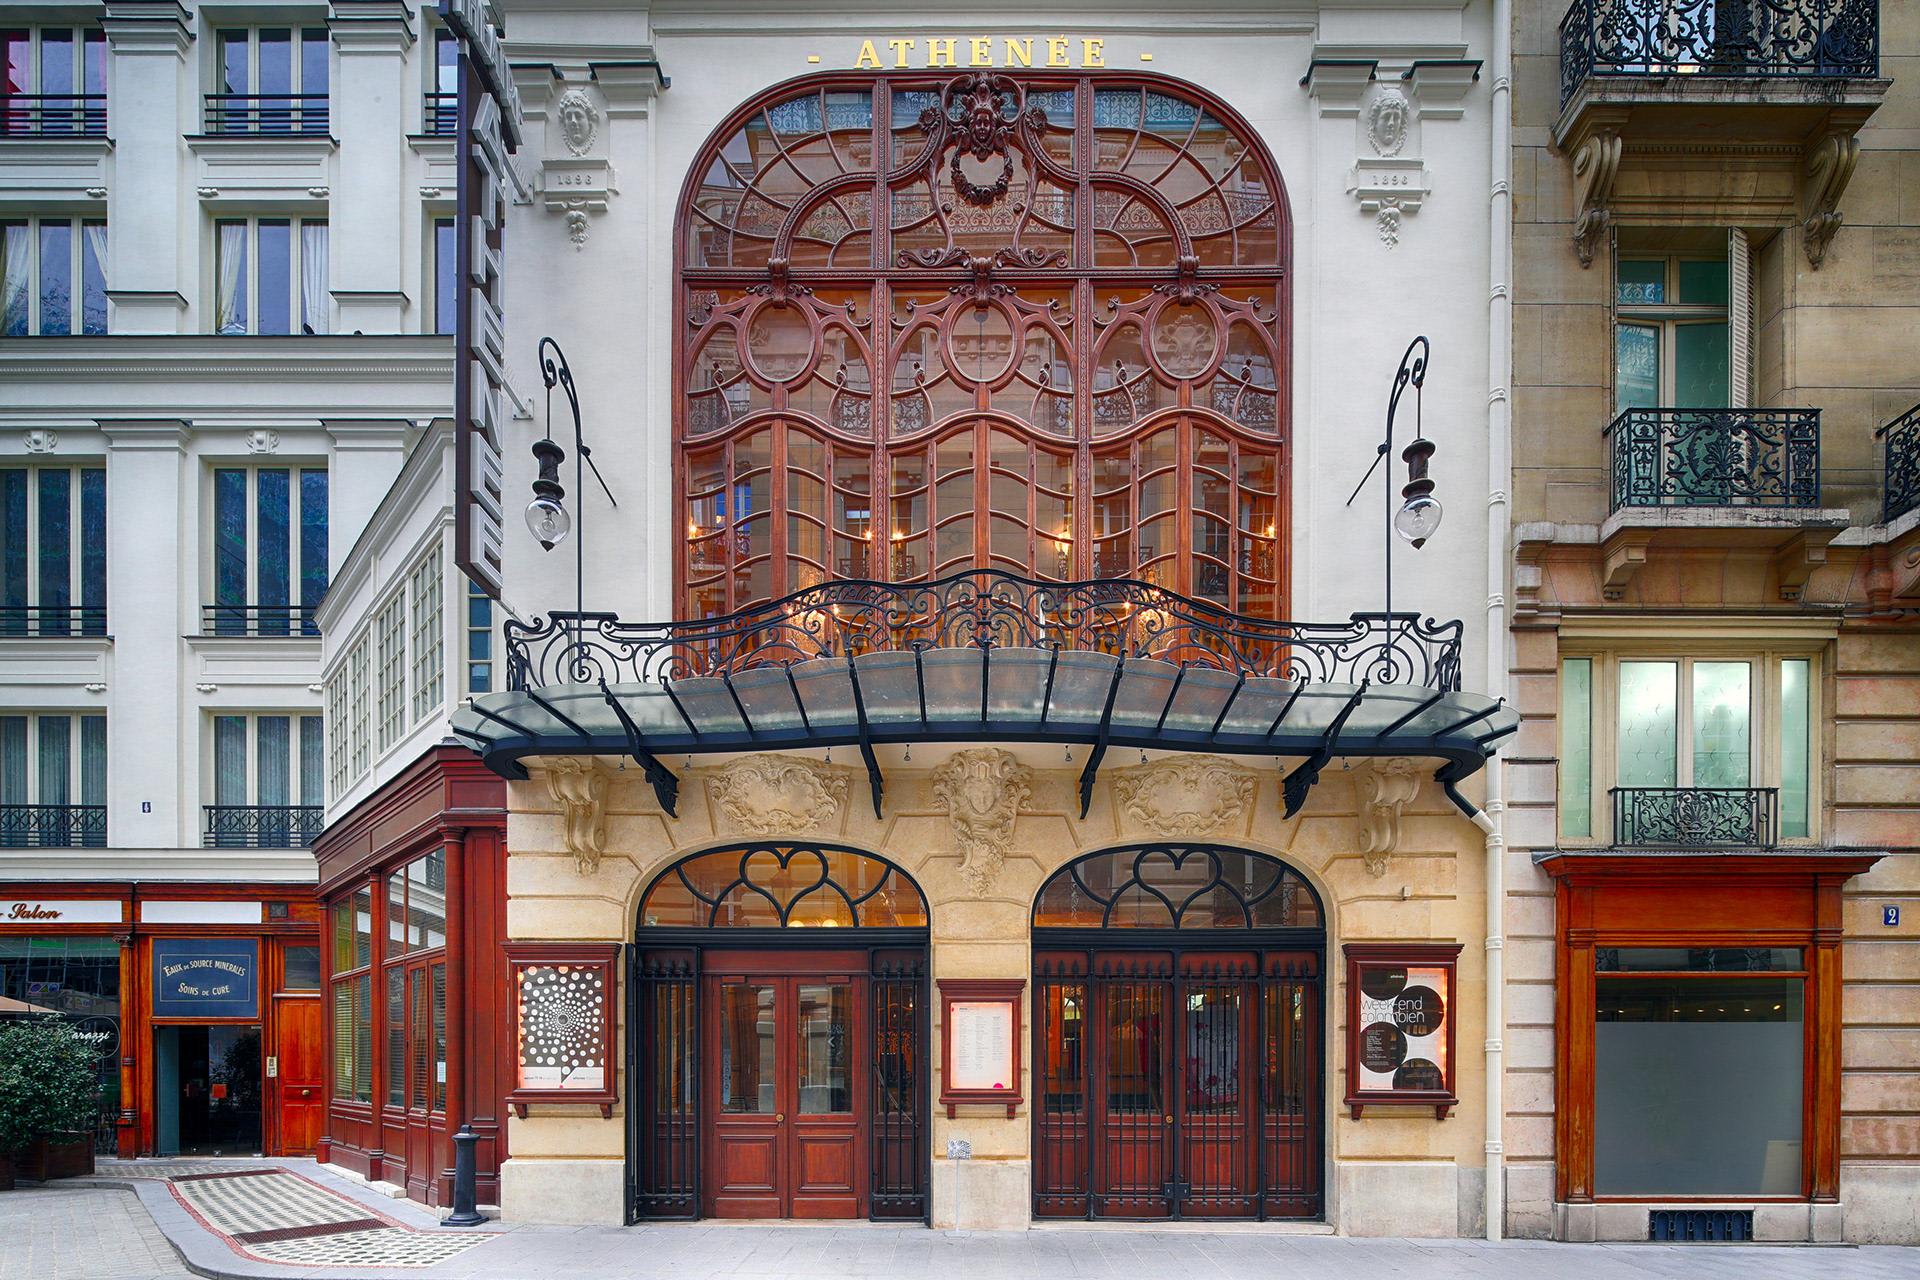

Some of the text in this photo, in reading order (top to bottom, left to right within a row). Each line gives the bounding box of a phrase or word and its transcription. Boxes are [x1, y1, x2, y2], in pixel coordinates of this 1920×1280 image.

[853, 34, 1105, 69] ATHÉNÉE
[1373, 175, 1408, 186] 1896
[7, 902, 63, 920] Salon
[1888, 908, 1897, 924] 2
[163, 963, 184, 977] EAUX
[189, 959, 213, 969] SOURCE
[214, 960, 246, 977] MINERALES
[178, 982, 199, 996] SOINS
[212, 984, 231, 996] CURE
[1360, 996, 1423, 1011] week-end
[1360, 1010, 1425, 1024] colombien
